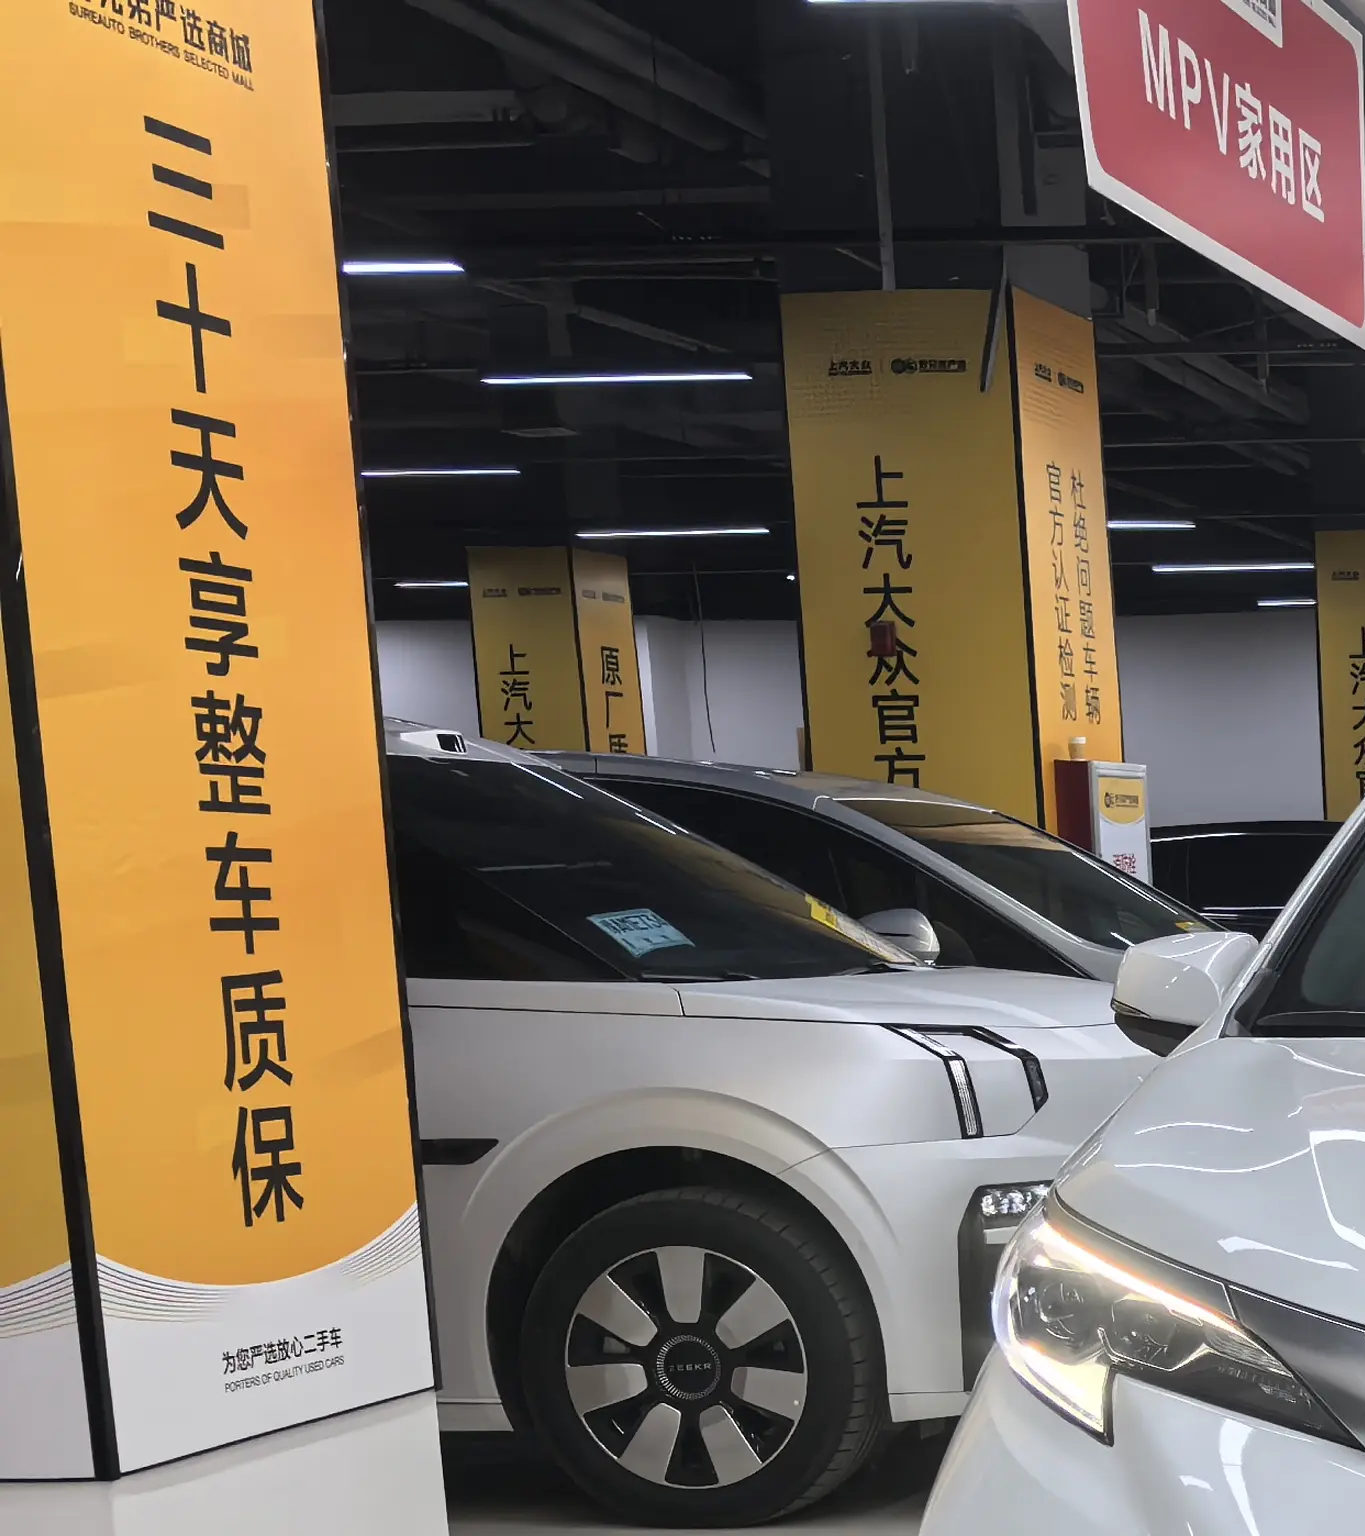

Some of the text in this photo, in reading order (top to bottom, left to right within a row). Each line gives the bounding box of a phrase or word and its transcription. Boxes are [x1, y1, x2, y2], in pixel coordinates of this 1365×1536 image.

[68, 1, 254, 91] SUREAUTO BROTHERS SELECTED MALL
[85, 0, 253, 73] 兄弟严选商城
[1138, 8, 1325, 223] MPV家用区
[1045, 461, 1078, 722] 官方认证检测
[143, 115, 304, 1228] 三十天享整车质保
[222, 1327, 343, 1375] 为您严选放心二手车
[273, 1365, 303, 1381] QUALITY
[304, 1360, 324, 1373] USED
